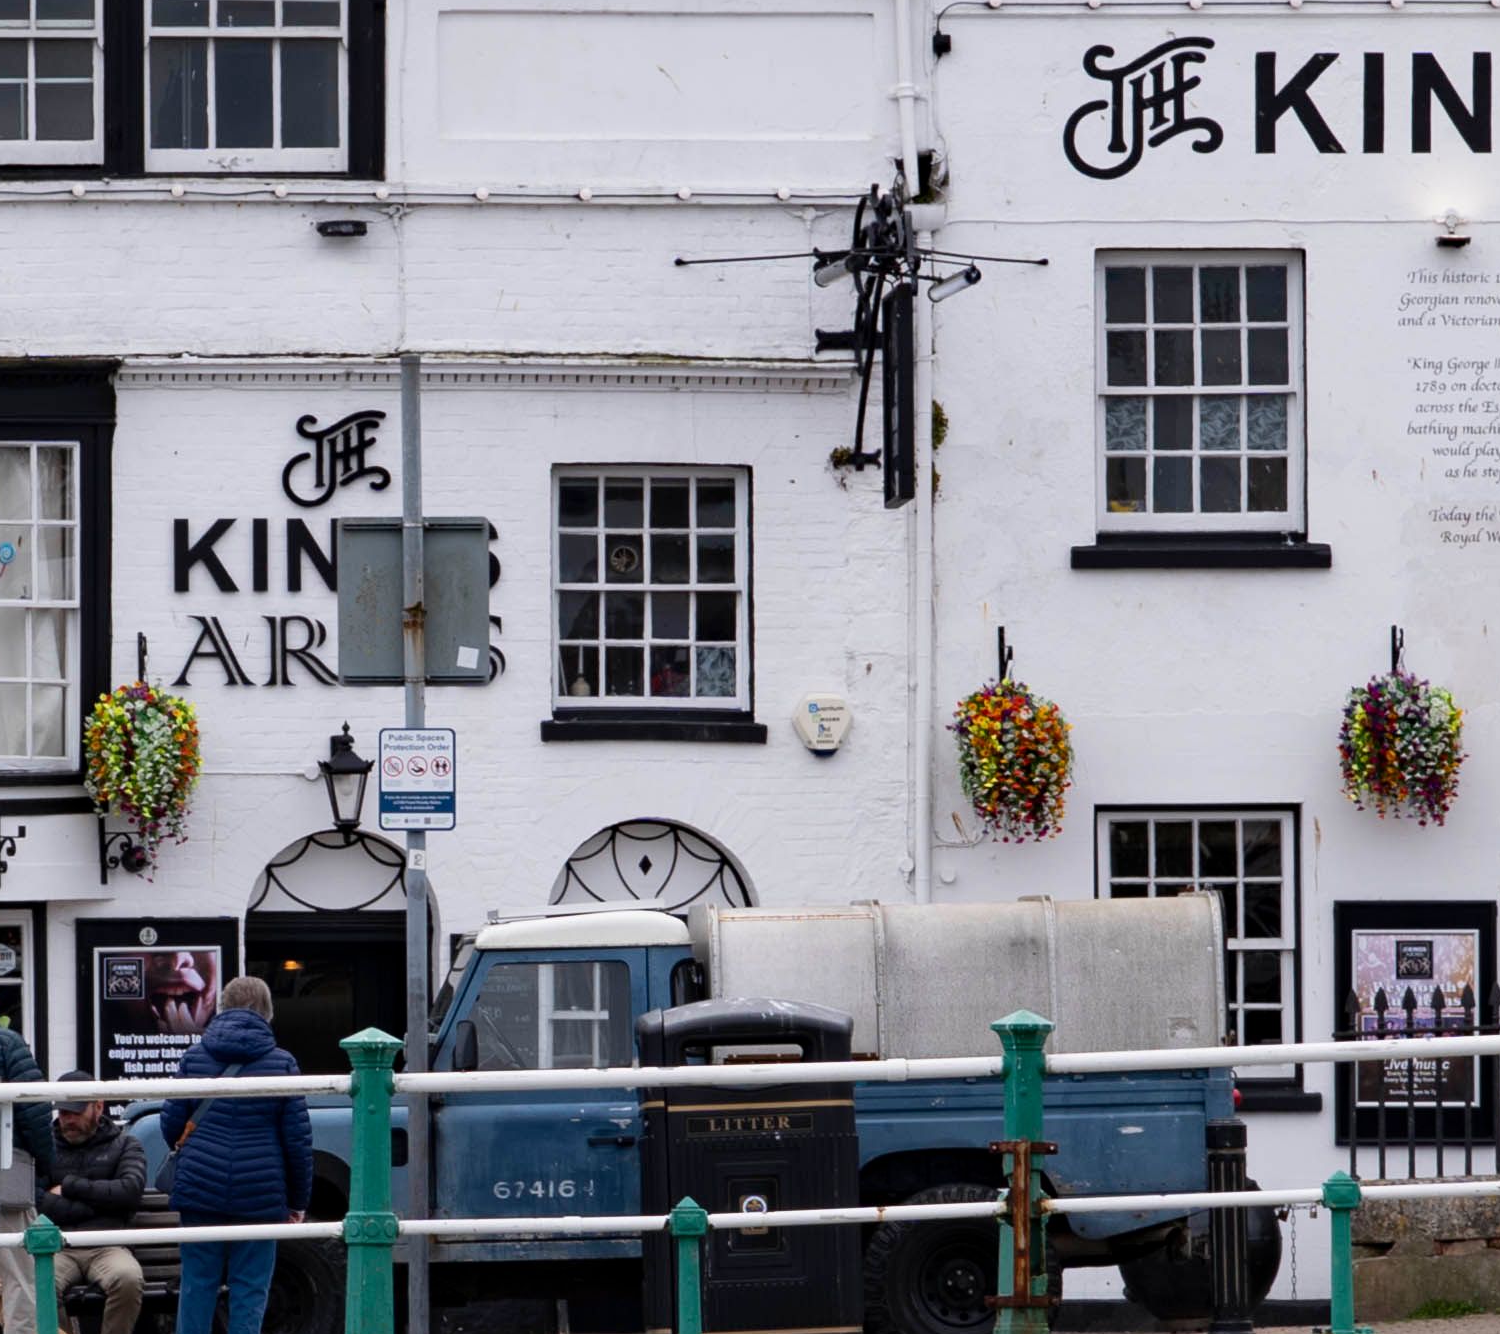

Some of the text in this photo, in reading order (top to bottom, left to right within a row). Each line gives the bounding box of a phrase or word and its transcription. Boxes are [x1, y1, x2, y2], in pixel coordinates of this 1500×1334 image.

[1408, 268, 1438, 283] This
[1442, 268, 1490, 283] historic
[1398, 293, 1459, 312] Georgian
[1398, 310, 1427, 326] and
[1428, 317, 1435, 325] a
[174, 517, 500, 593] KIN
[416, 734, 444, 742] Spaces
[114, 1034, 144, 1044] You're
[146, 1034, 192, 1044] welcome
[109, 1048, 160, 1059] enjoy your
[125, 1062, 163, 1072] fish and
[710, 1117, 790, 1133] LITTER
